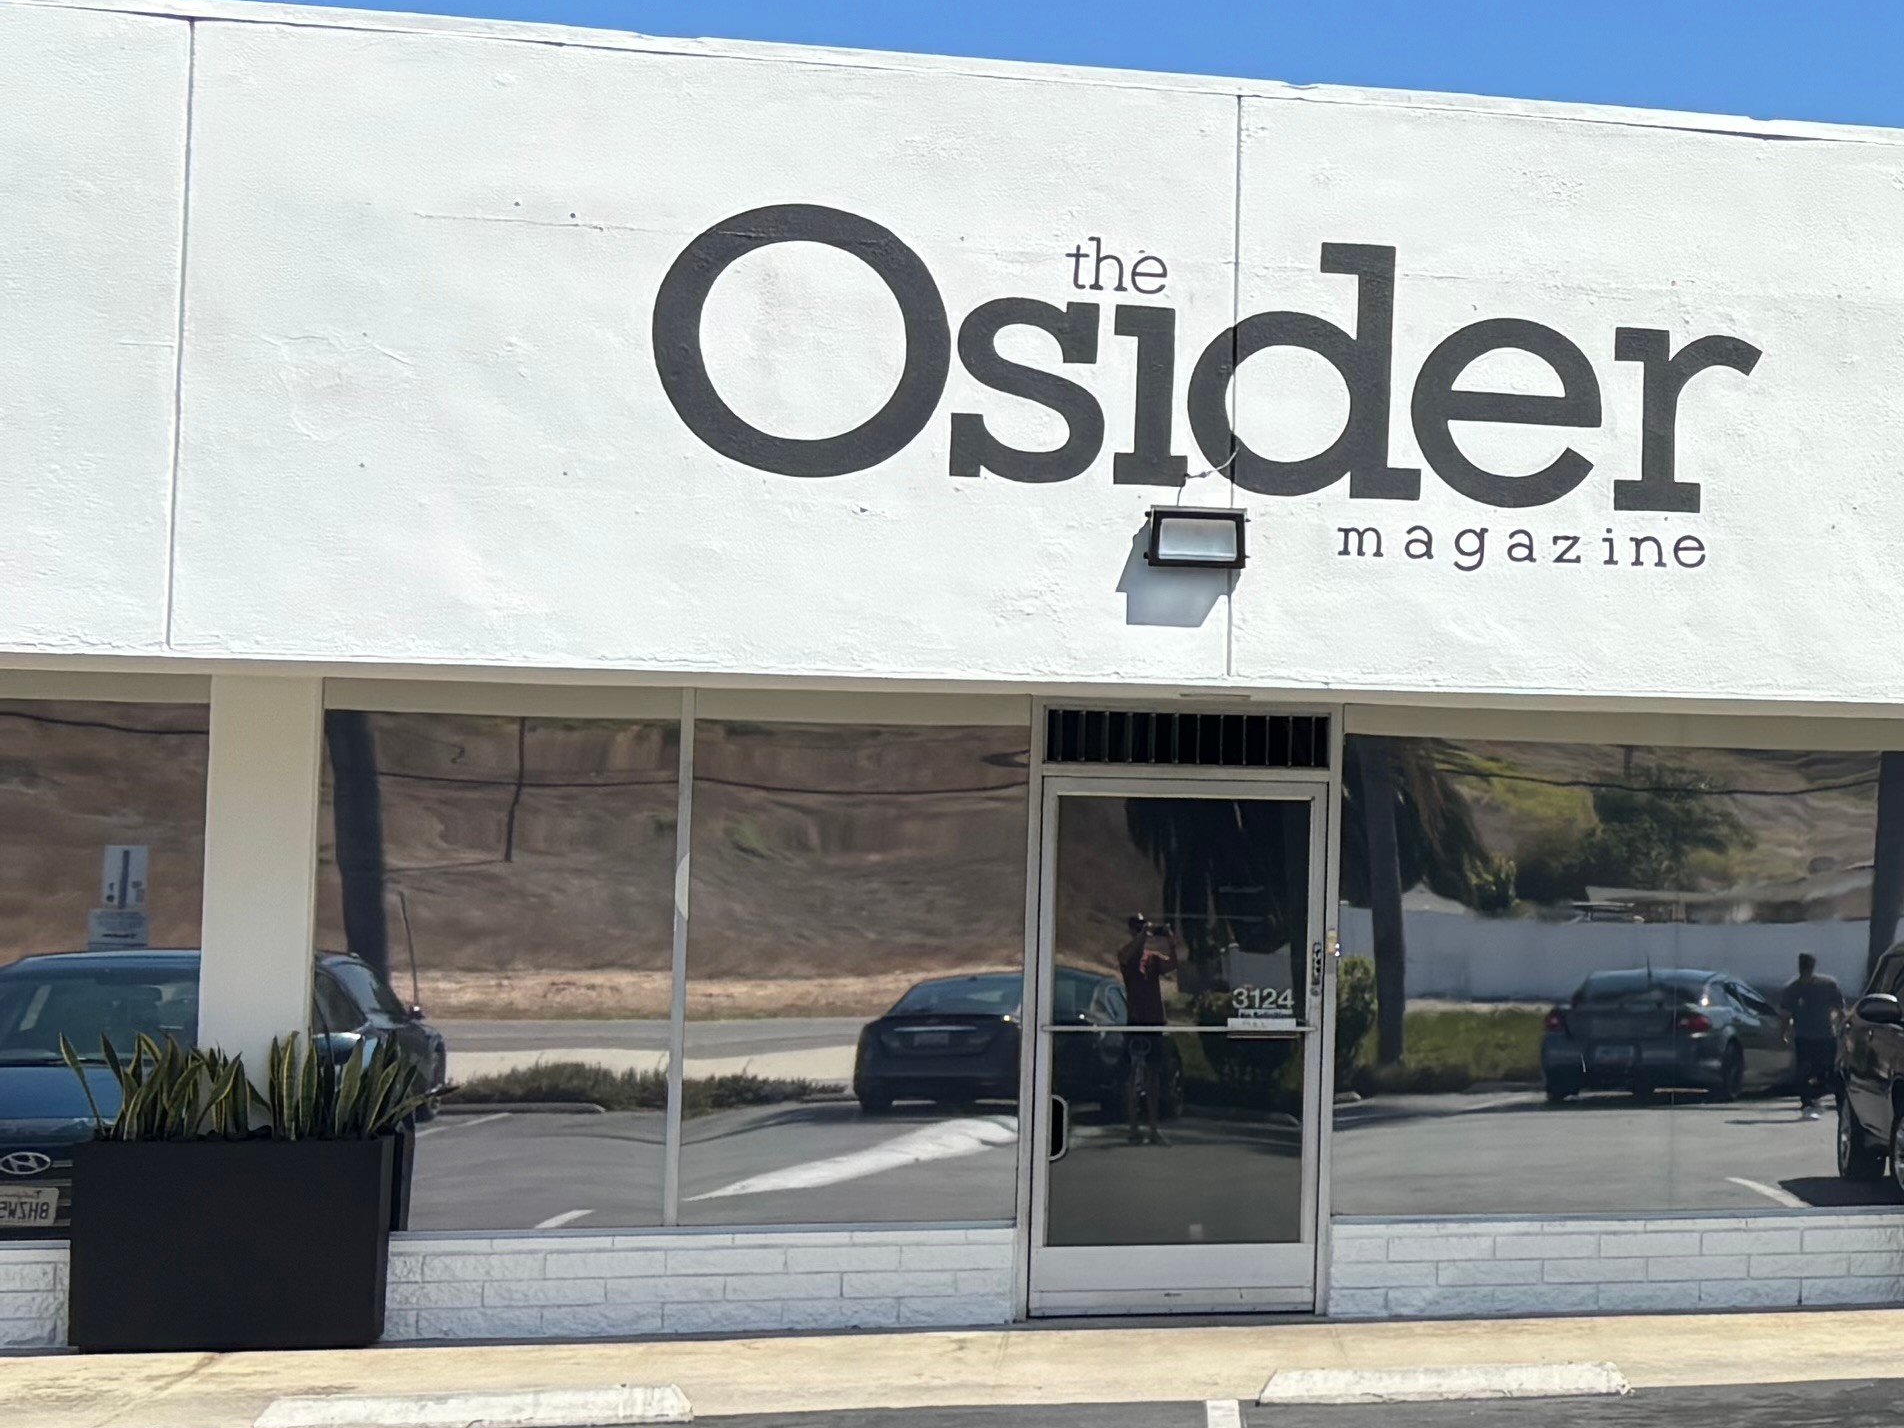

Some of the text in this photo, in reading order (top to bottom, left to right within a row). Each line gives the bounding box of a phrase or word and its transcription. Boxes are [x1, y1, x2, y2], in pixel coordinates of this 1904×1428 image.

[1066, 236, 1168, 295] the
[651, 203, 1763, 513] Osider
[1336, 520, 1708, 572] magazine
[1232, 988, 1295, 1009] 3124
